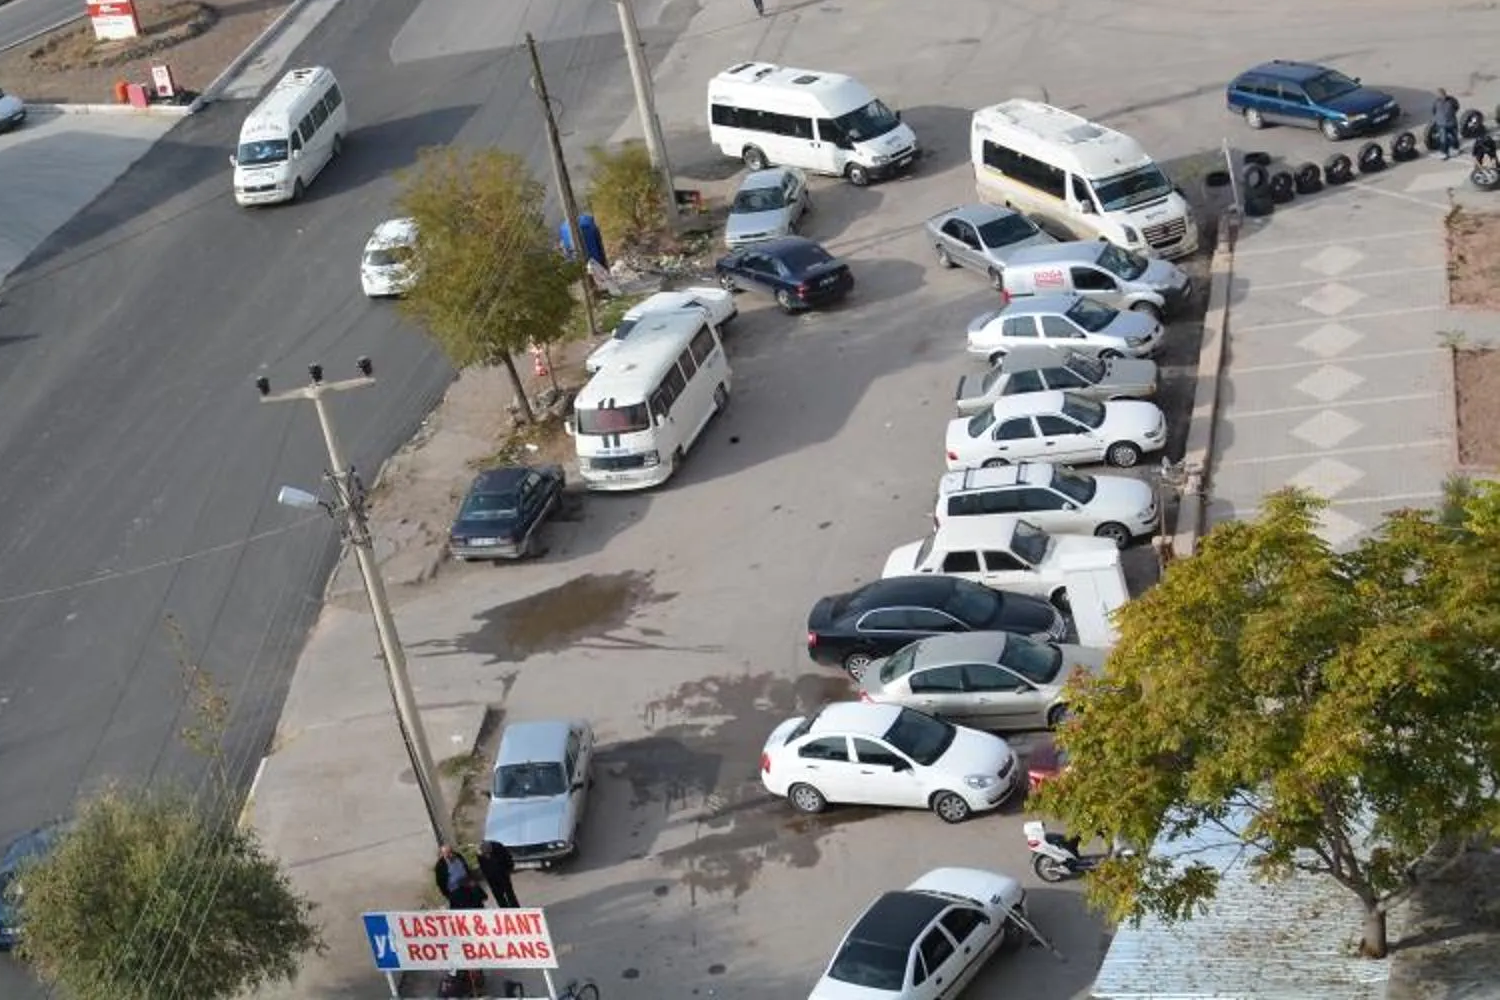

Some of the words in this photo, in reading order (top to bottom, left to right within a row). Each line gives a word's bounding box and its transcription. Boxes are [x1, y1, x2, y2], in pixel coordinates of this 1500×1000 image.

[473, 915, 488, 937] &
[492, 913, 542, 937] JANT
[407, 943, 449, 961] ROT
[461, 941, 550, 961] BALANS
